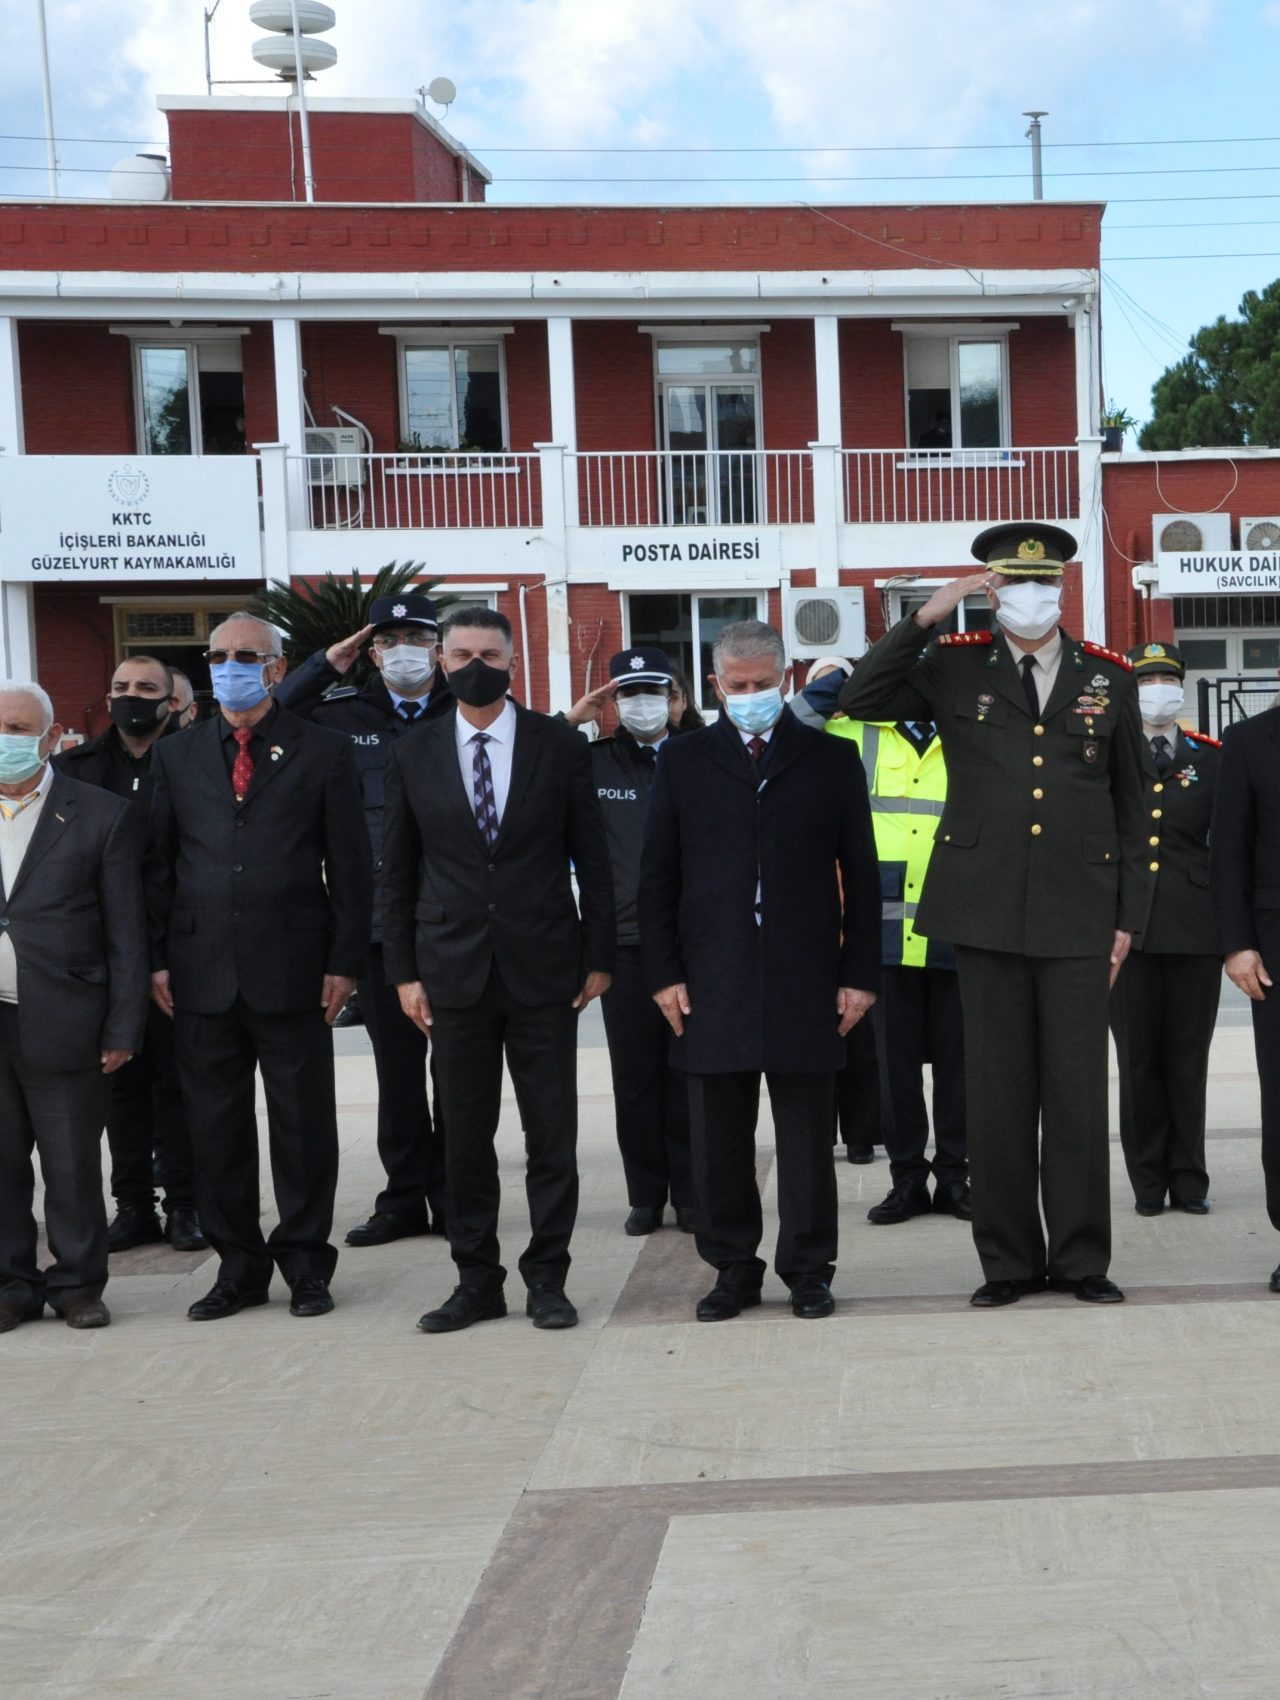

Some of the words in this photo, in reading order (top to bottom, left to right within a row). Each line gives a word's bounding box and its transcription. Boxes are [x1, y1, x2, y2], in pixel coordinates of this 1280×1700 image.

[112, 513, 152, 525] KKTC
[60, 532, 121, 551] İÇİŞLERİ
[127, 532, 206, 548] BAKANLIĞI
[622, 544, 682, 562] POSTA
[688, 537, 759, 561] DAİRESİ
[31, 554, 118, 570] GÜZELYURT
[124, 553, 235, 570] KAYMAKAMLIĞI
[1180, 556, 1243, 573] HUKUK
[598, 788, 636, 800] POLIS
